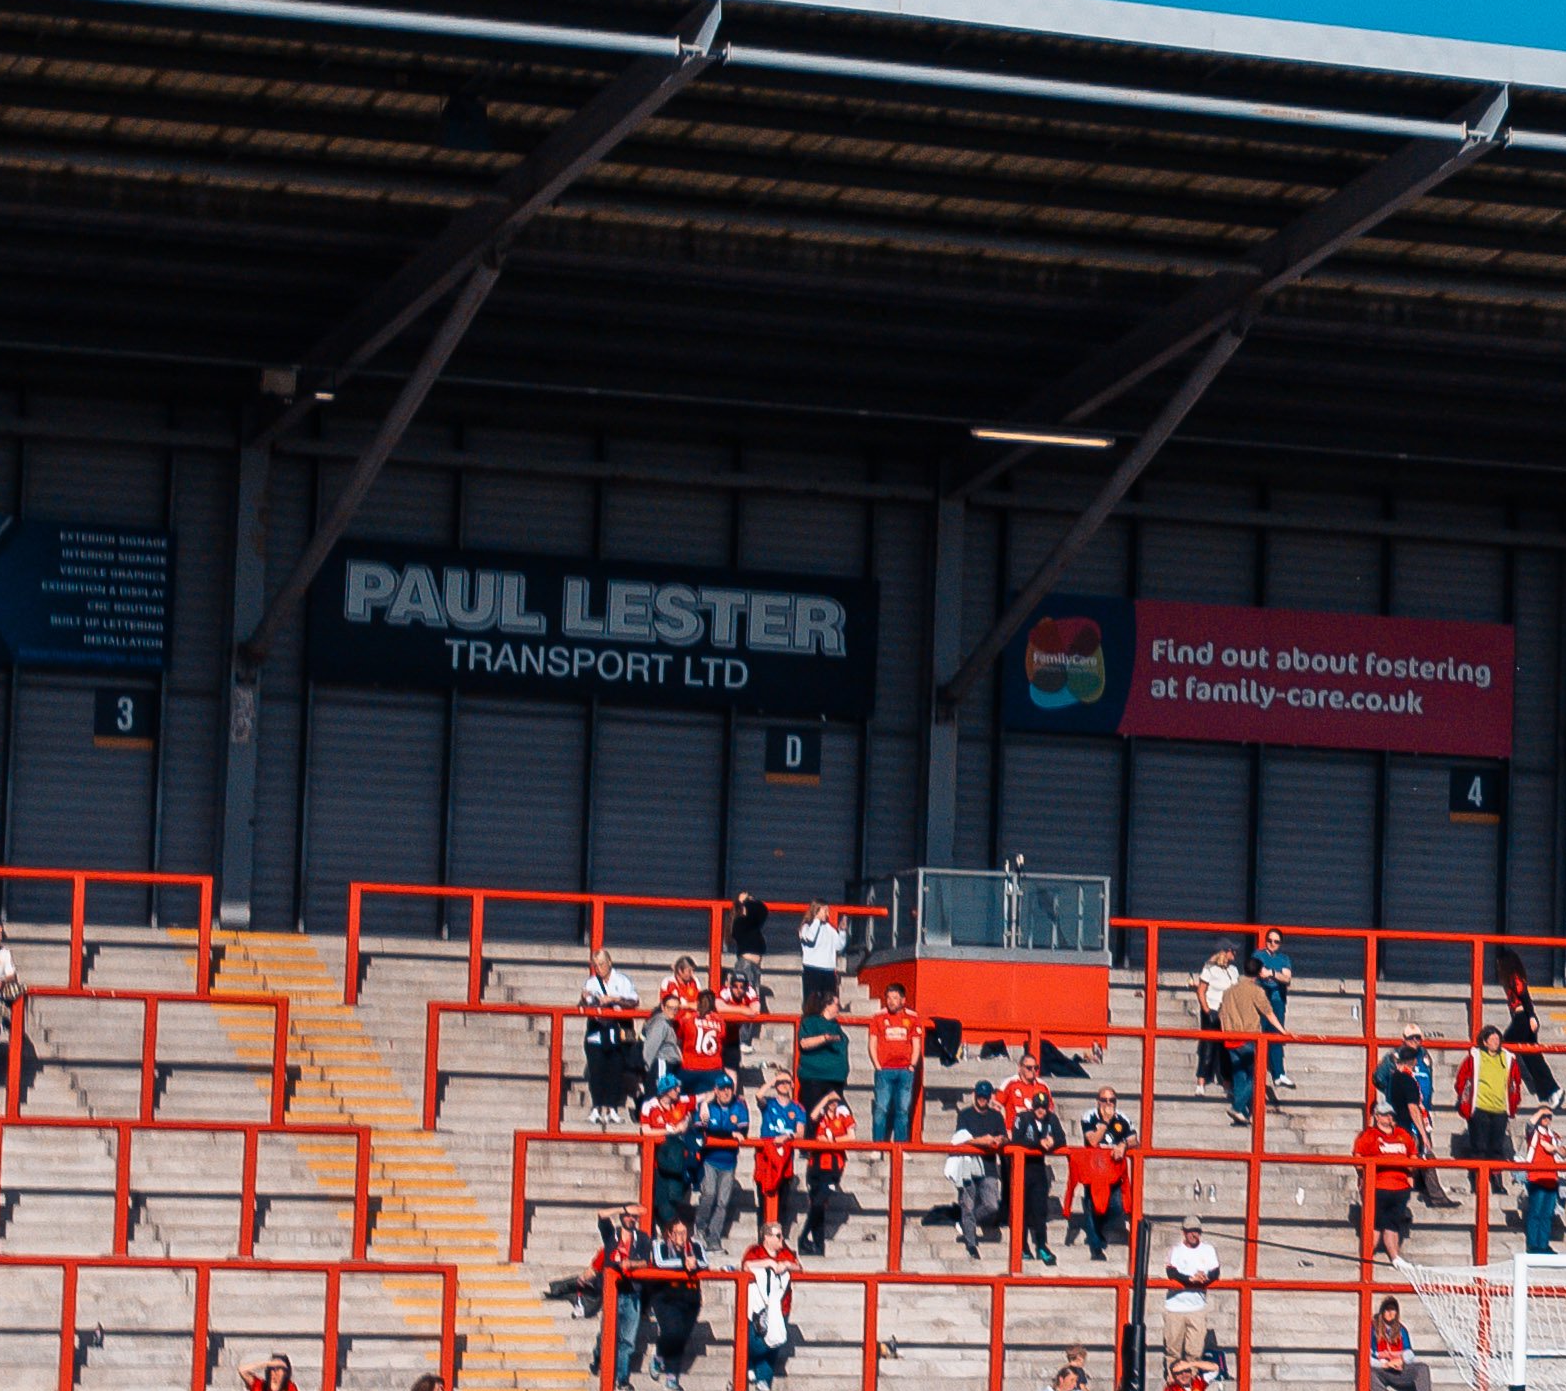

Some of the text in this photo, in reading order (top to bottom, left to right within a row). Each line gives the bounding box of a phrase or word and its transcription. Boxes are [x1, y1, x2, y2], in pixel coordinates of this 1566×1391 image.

[60, 531, 167, 548] EXTERIOR SIGNAGE
[62, 548, 166, 565] INTERIOR SIGNAGE
[60, 564, 166, 582] VEHICLE GRAPHICS
[41, 580, 105, 595] EXHIBITION
[119, 586, 164, 598] DISPLAY
[50, 614, 163, 632] BUILT UP LETTERING
[114, 602, 164, 616] ROUTING
[345, 559, 846, 657] PAUL LESTER
[83, 634, 163, 649] INSTALLATION
[445, 638, 748, 689] TRANSPORT LTD
[1152, 639, 1491, 689] Find out about fostering
[1151, 676, 1423, 715] at family-care.co.uk
[117, 696, 133, 731] 3
[786, 734, 802, 768] D
[1467, 775, 1483, 807] 4
[695, 1025, 718, 1056] 16
